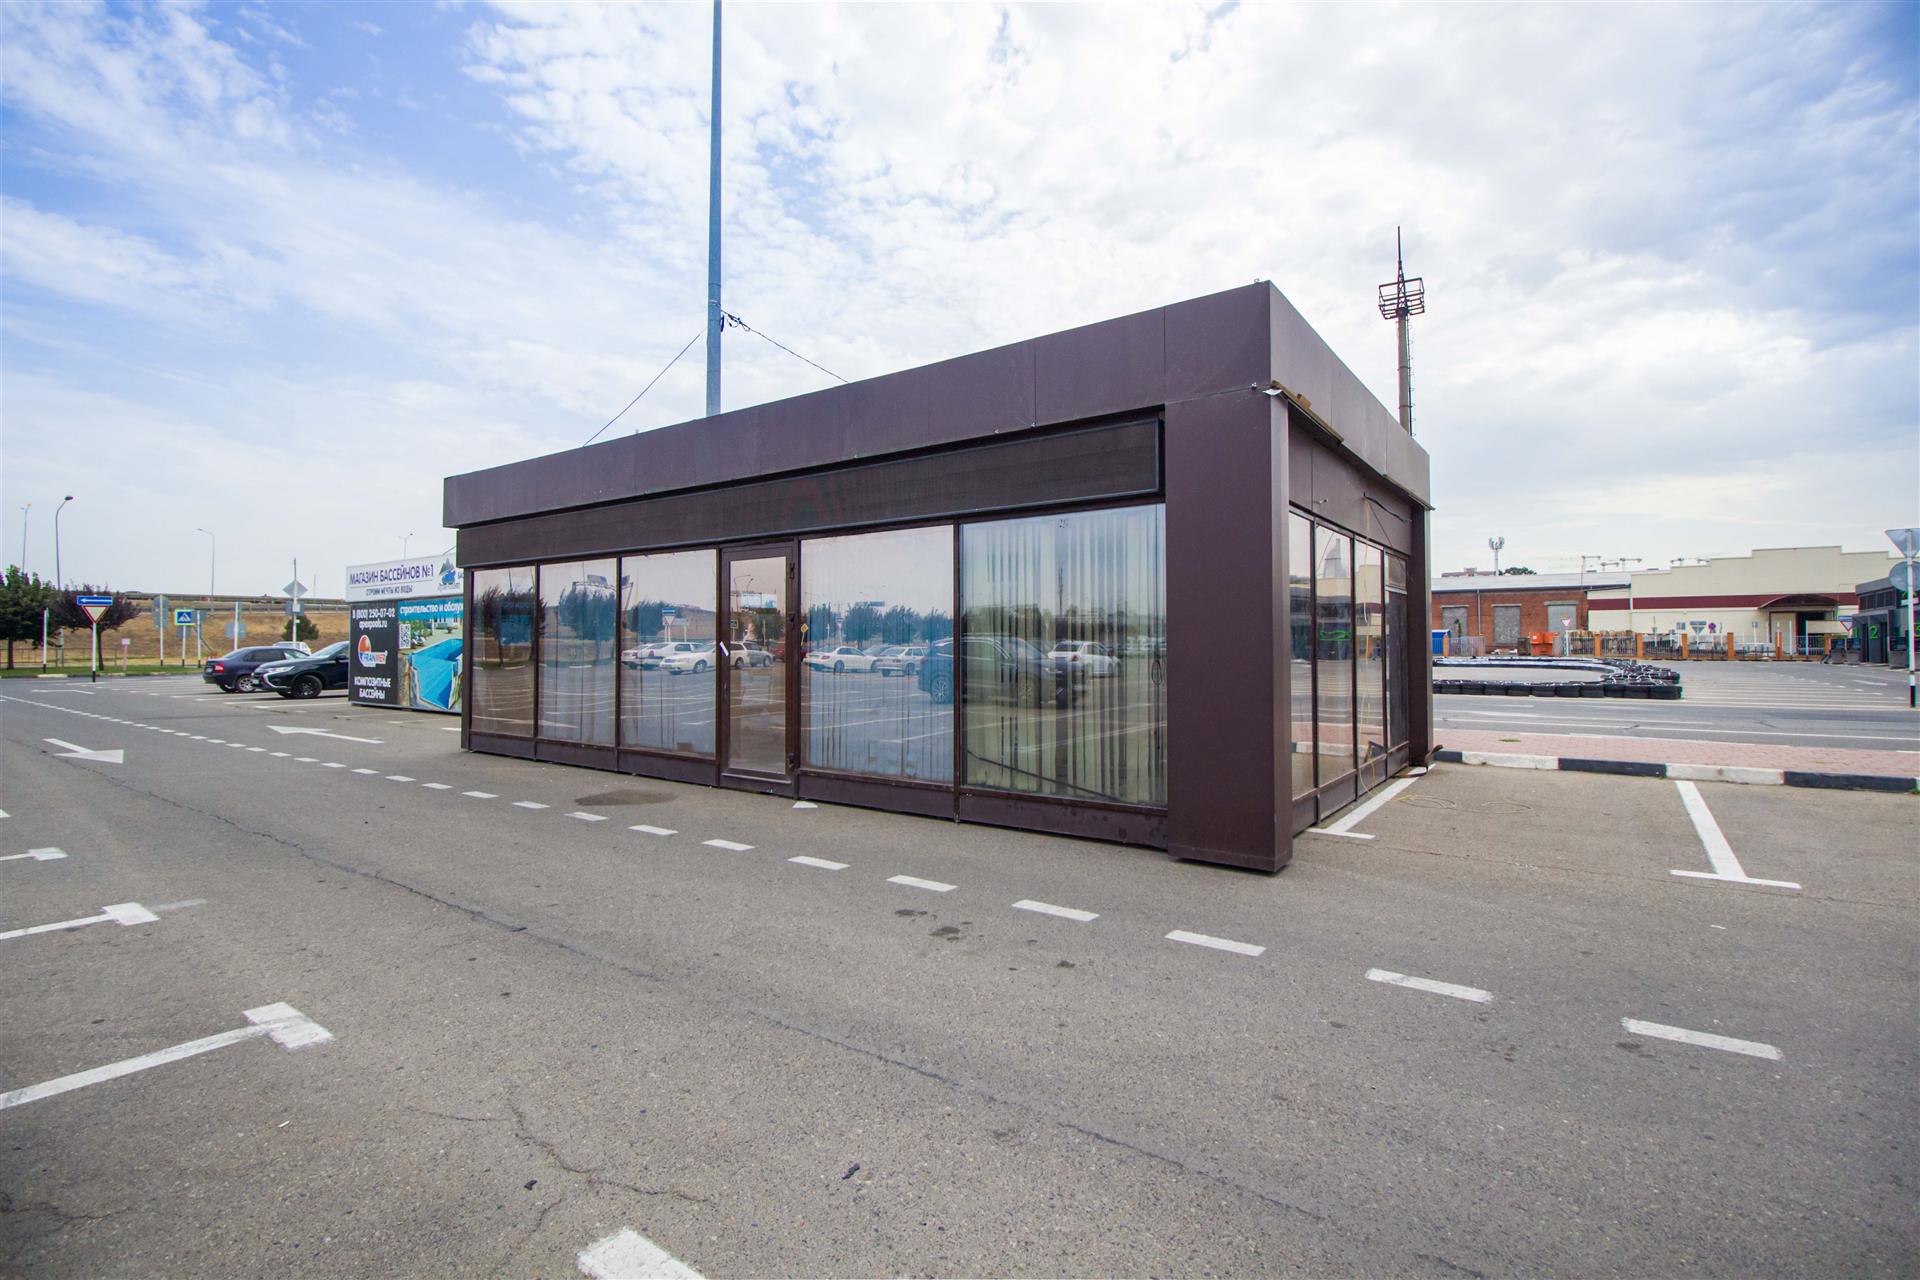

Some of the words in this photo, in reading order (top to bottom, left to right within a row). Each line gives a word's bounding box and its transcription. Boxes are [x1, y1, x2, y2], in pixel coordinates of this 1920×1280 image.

[350, 572, 378, 585] МАГАЗИН
[380, 564, 420, 583] БАССЕЙНОВ
[399, 604, 438, 617] строительство
[1870, 625, 1878, 638] 2
[359, 687, 386, 699] БАССЕЙНЫ
